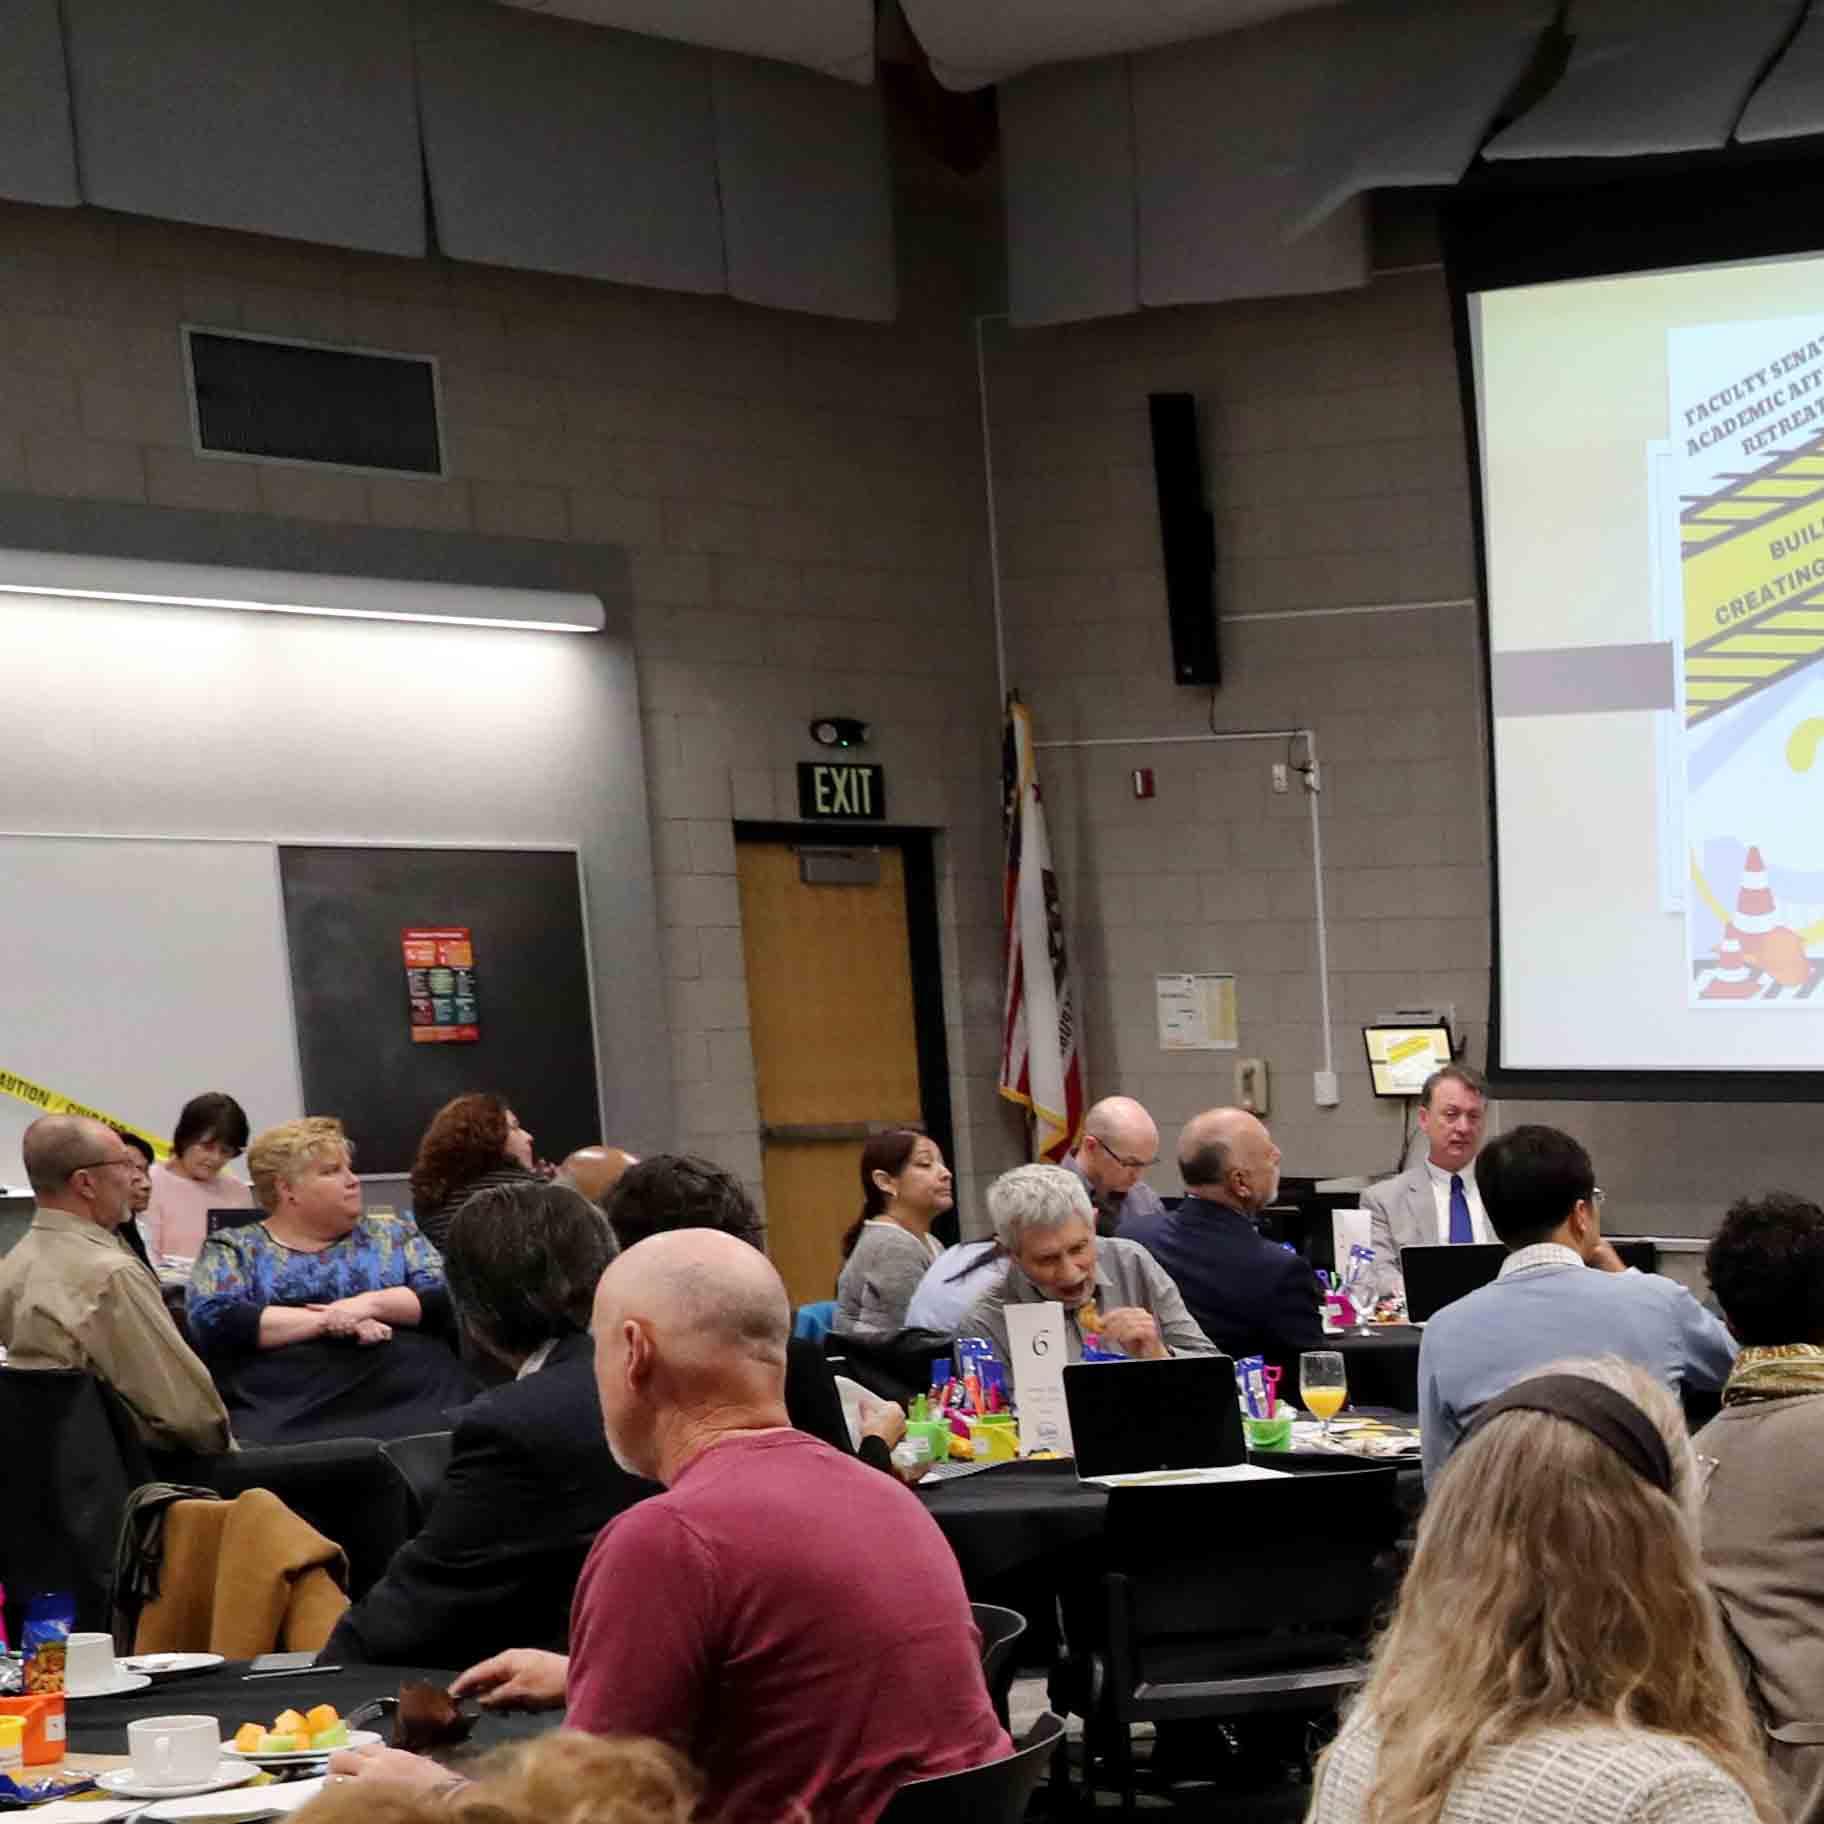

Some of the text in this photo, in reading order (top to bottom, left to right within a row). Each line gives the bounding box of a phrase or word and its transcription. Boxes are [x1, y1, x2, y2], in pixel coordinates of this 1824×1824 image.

[1684, 368, 1768, 428] FACULTY
[1686, 390, 1786, 456] ACADEMIC
[814, 766, 872, 814] EXIT
[0, 1071, 50, 1106] AUTION
[1032, 1329, 1050, 1357] 6
